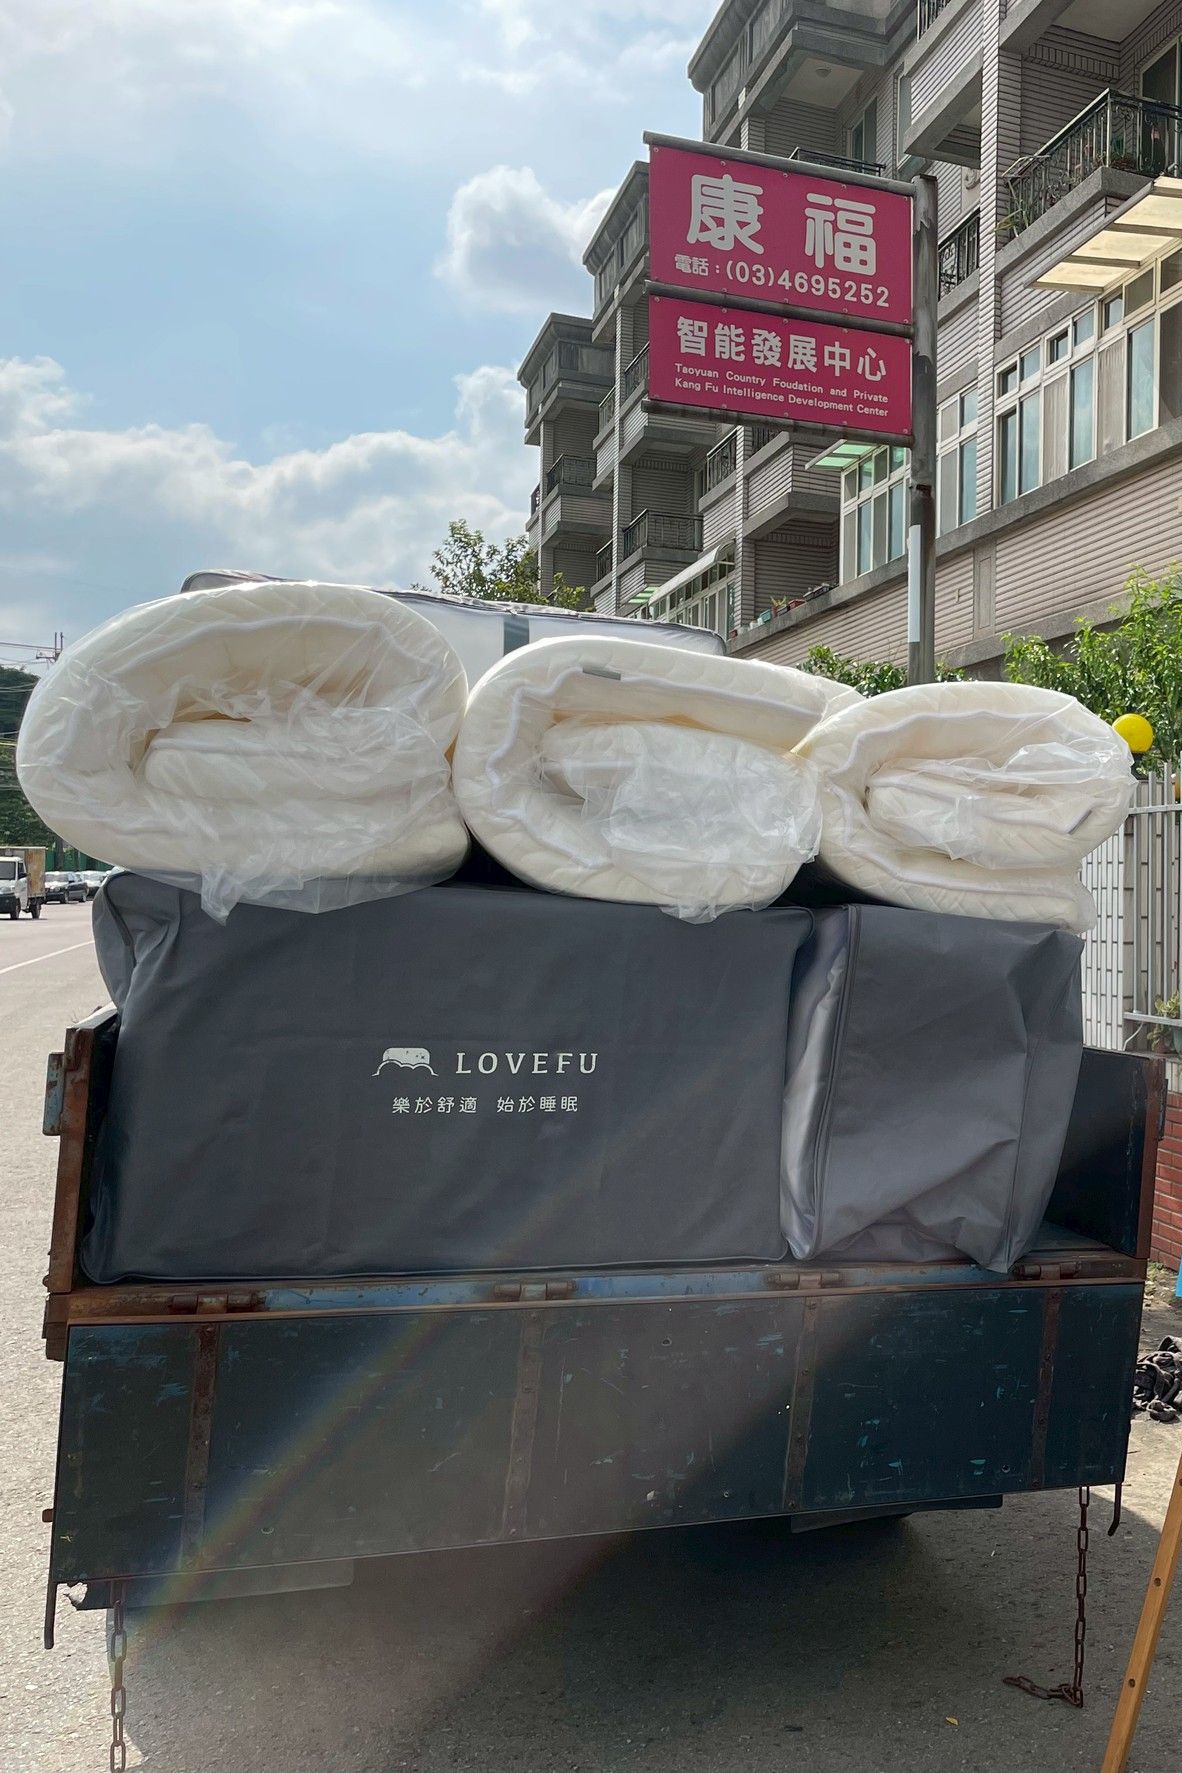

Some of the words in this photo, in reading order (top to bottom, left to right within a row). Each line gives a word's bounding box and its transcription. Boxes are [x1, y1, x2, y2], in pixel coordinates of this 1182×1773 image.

[687, 174, 877, 277] 康福
[726, 260, 890, 308] (03)4695252
[676, 316, 887, 382] 智能發展中心
[674, 362, 719, 379] Taoyuan
[725, 370, 767, 387] Country
[772, 377, 824, 394] Foudation
[830, 387, 848, 397] and
[853, 389, 889, 403] Private
[674, 377, 701, 392] Kang
[705, 382, 719, 393] Fu
[723, 384, 785, 402] Intelligence
[788, 394, 854, 412] Development
[857, 404, 889, 417] Center
[455, 1052, 599, 1075] LOVEFU
[392, 1096, 478, 1114] 樂於舒適
[497, 1095, 579, 1113] 始於睡眠
